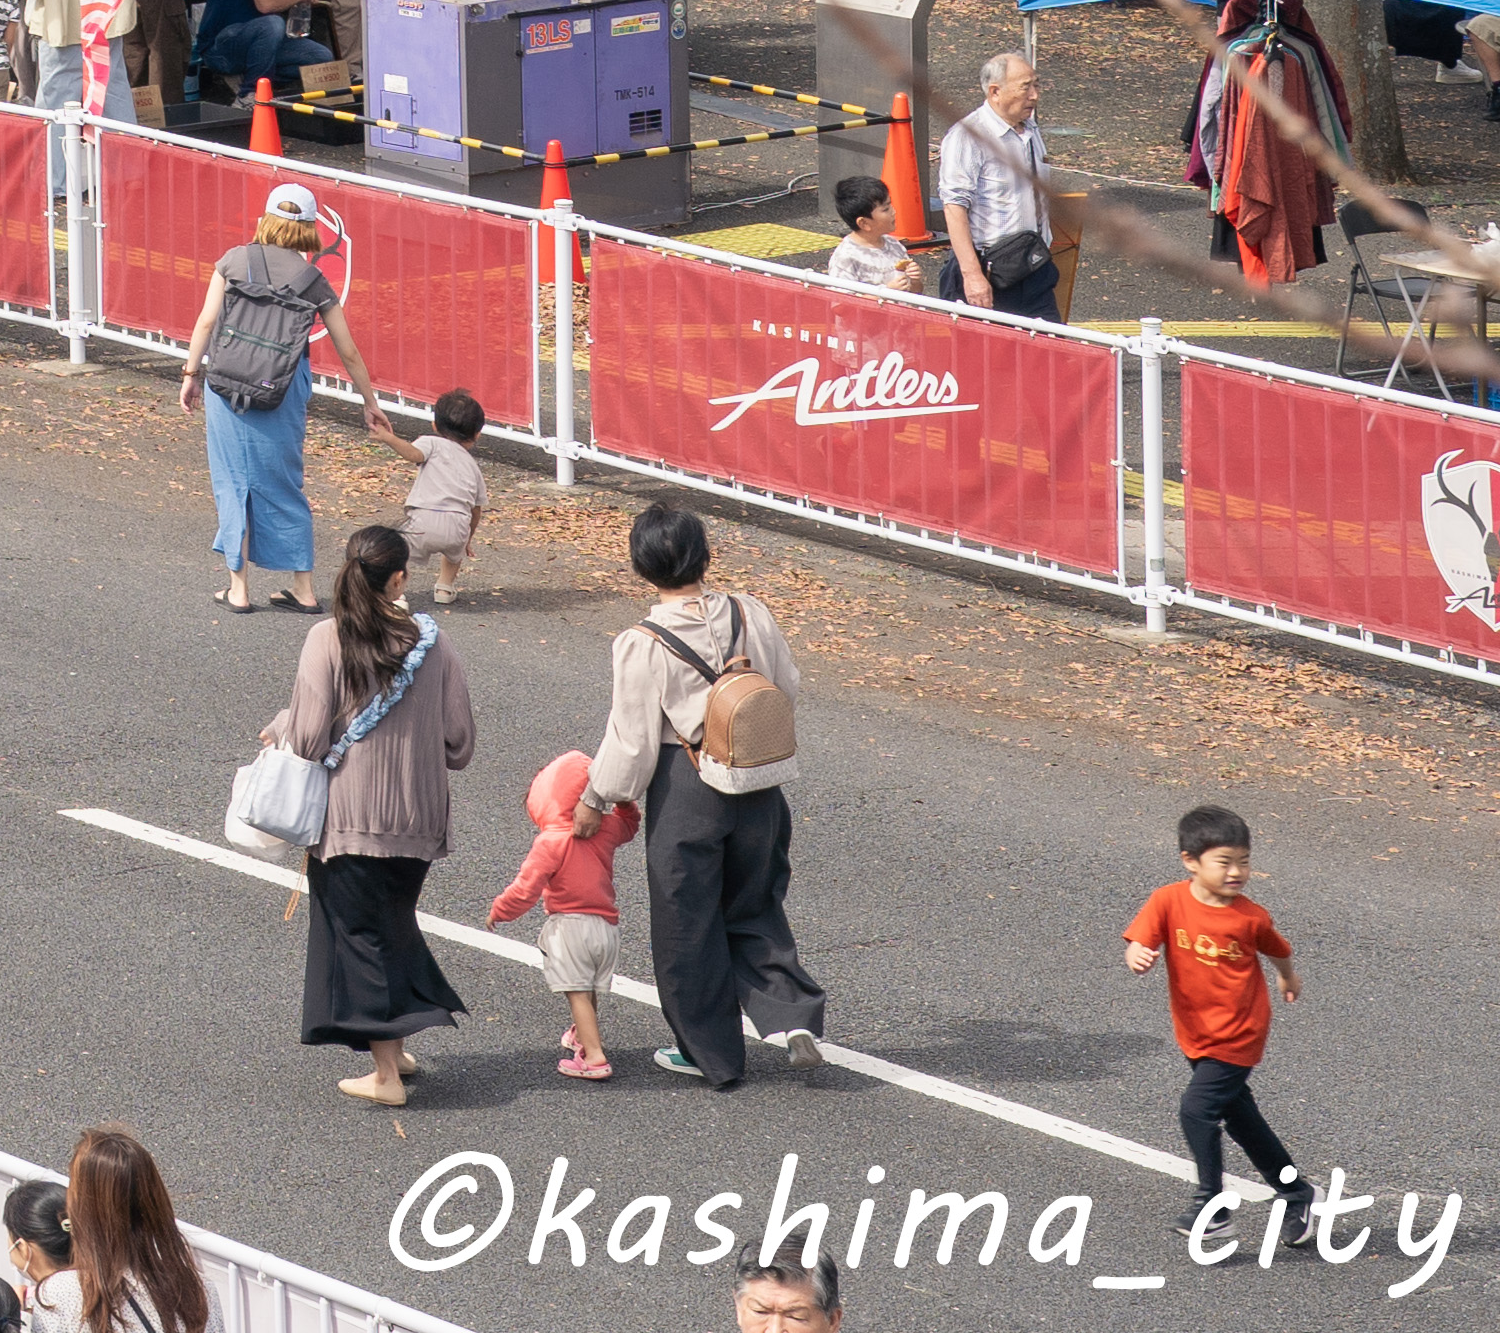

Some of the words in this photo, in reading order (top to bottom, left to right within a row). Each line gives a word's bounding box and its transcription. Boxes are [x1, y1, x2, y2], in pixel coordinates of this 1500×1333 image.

[526, 19, 572, 48] 13LS
[613, 85, 655, 102] TMK-514
[751, 318, 858, 354] KASHIMA
[708, 349, 980, 432] Antlers
